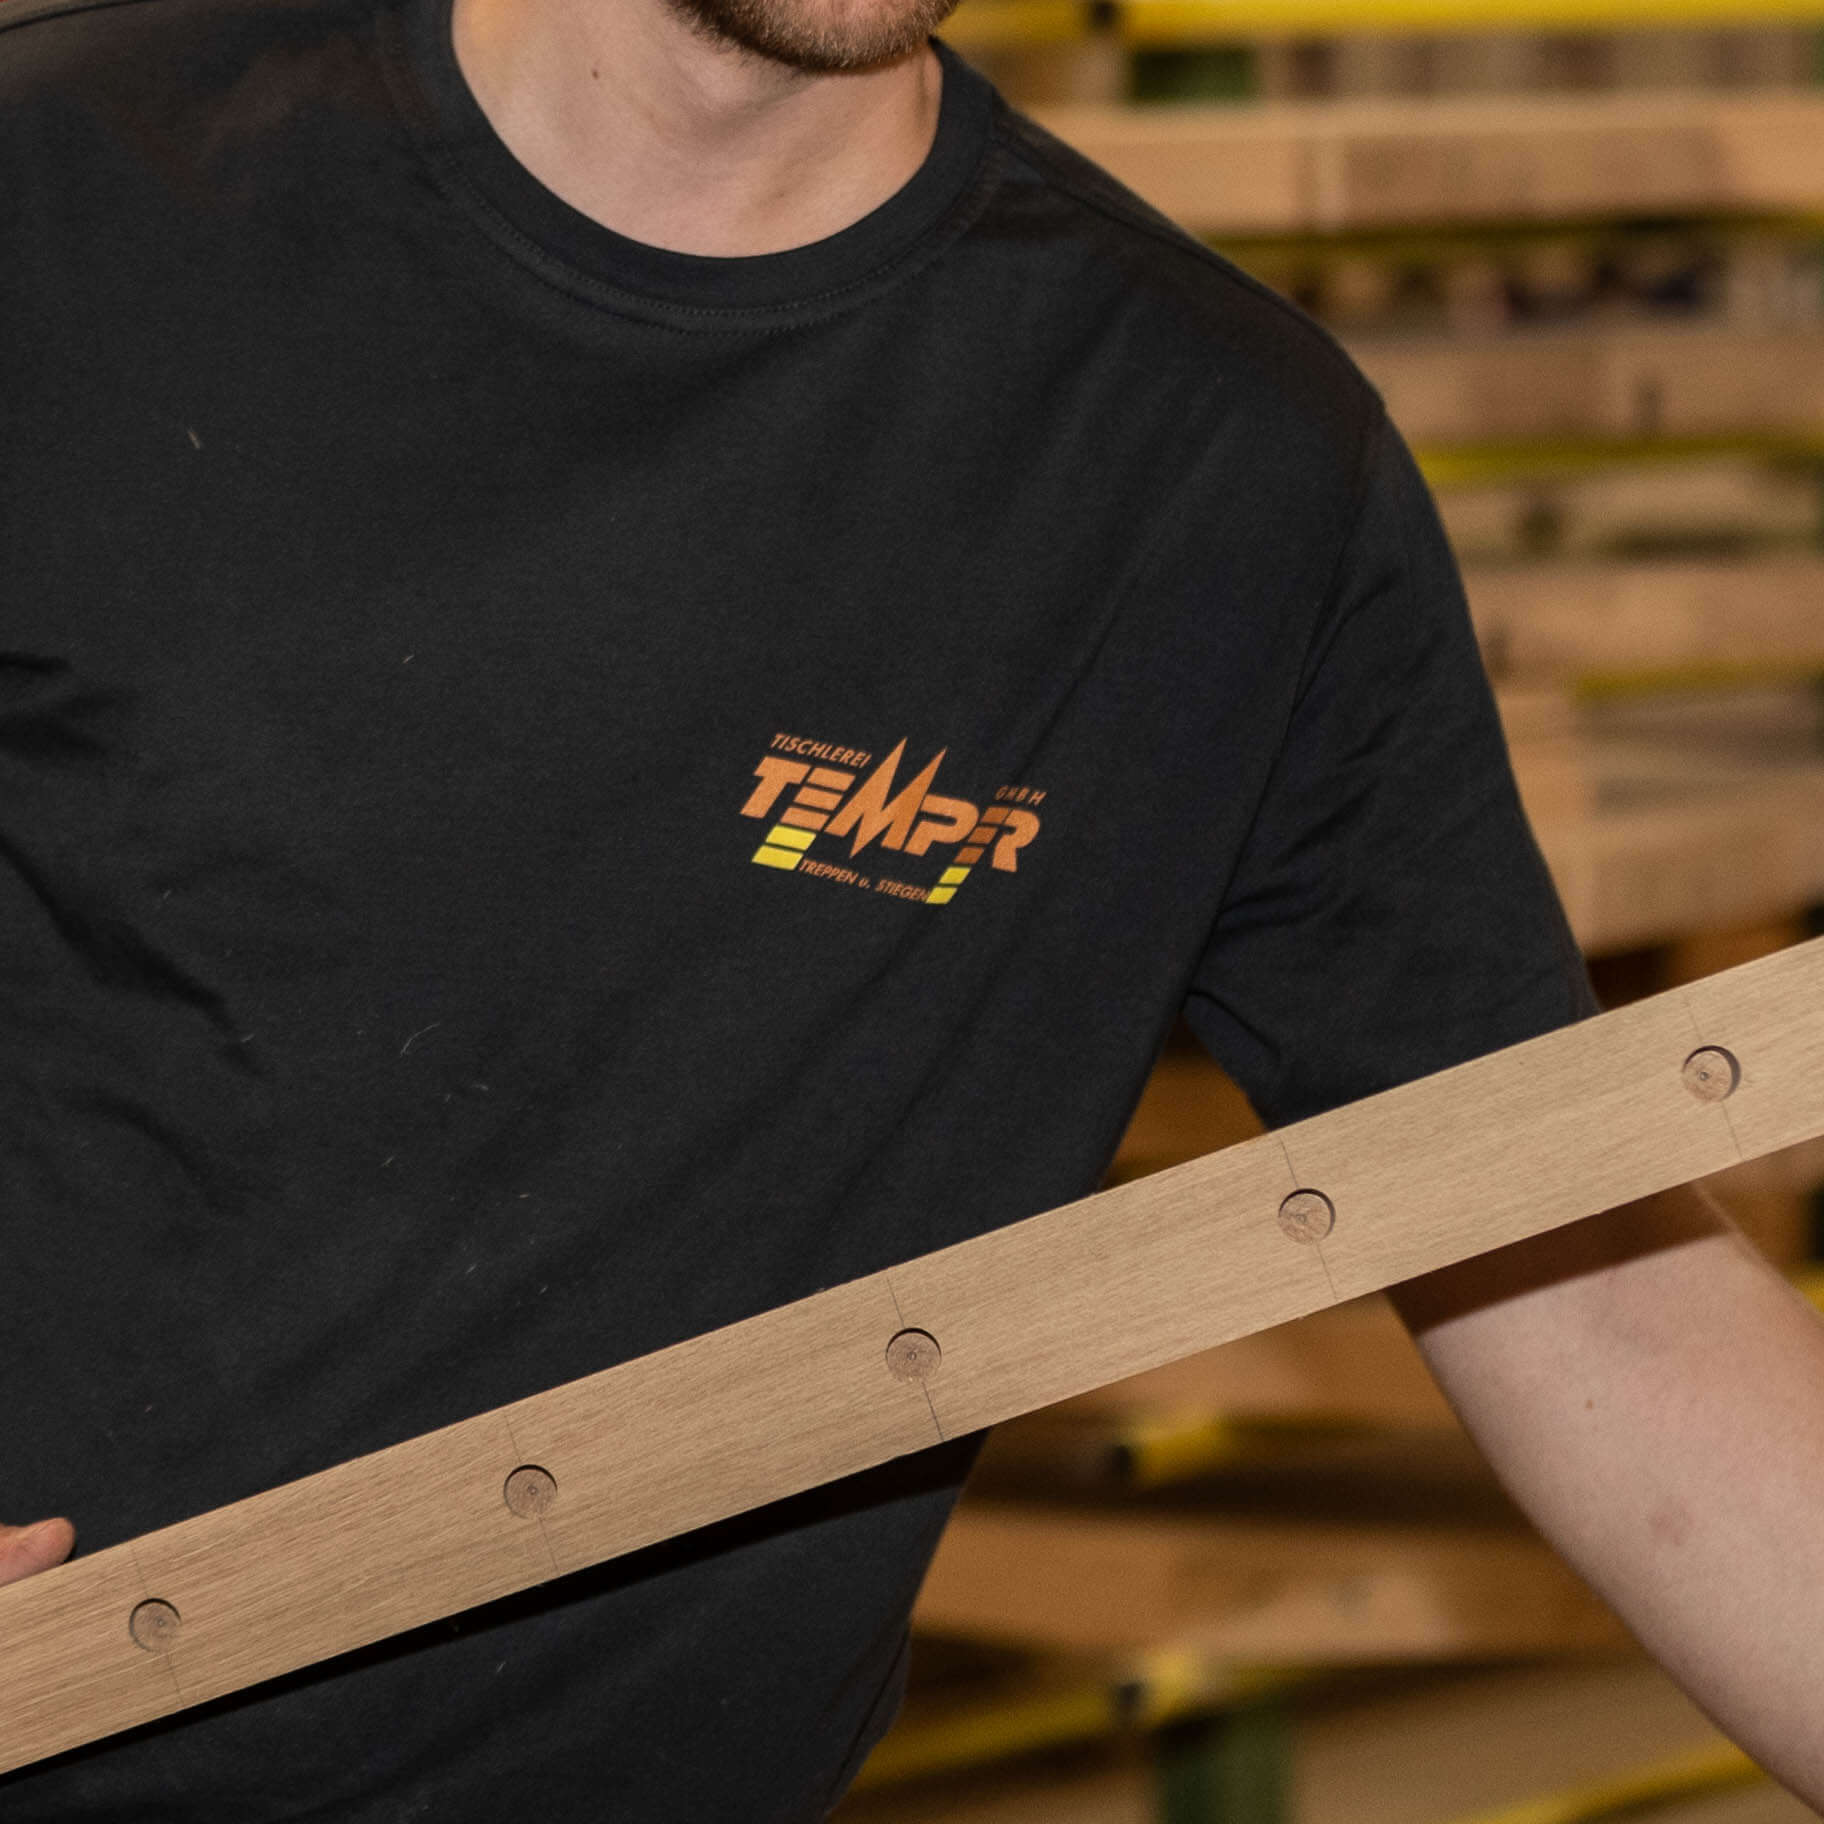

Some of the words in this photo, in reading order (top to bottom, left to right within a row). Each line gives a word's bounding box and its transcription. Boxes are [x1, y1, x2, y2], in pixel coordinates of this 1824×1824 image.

[770, 733, 872, 767] TISCHLEREI
[799, 859, 858, 884] TREPPEN
[875, 879, 930, 902] STIEGEN
